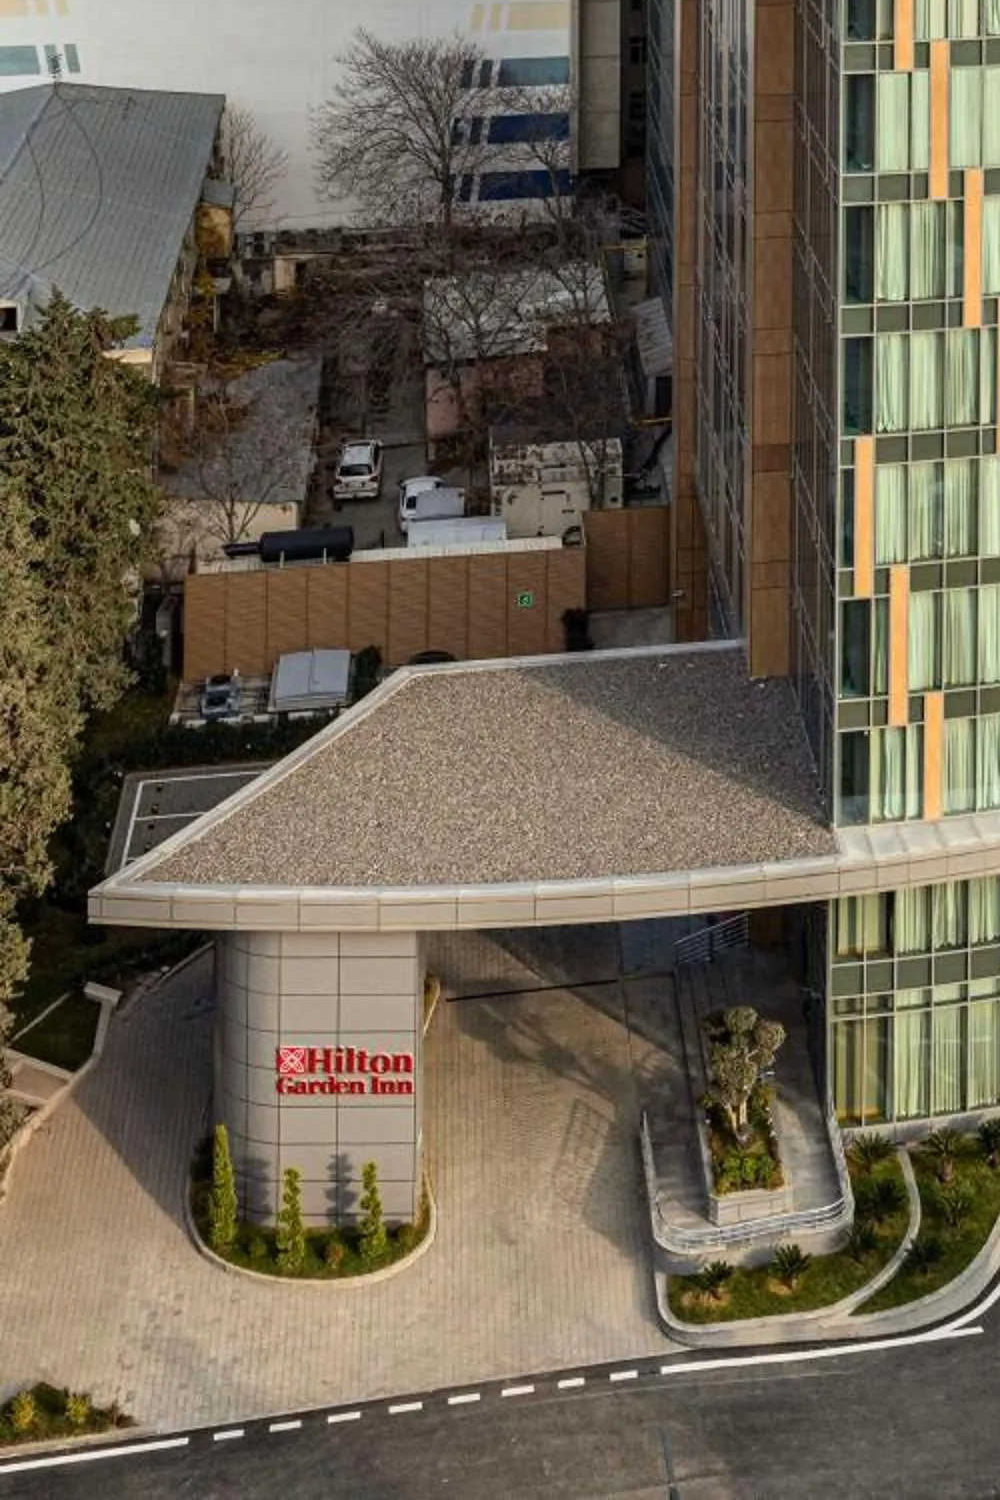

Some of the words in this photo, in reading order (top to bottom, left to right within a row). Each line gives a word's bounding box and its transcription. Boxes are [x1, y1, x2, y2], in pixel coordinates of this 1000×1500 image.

[307, 1047, 413, 1074] Hilton
[276, 1075, 366, 1095] Garden
[370, 1076, 414, 1095] Inn
